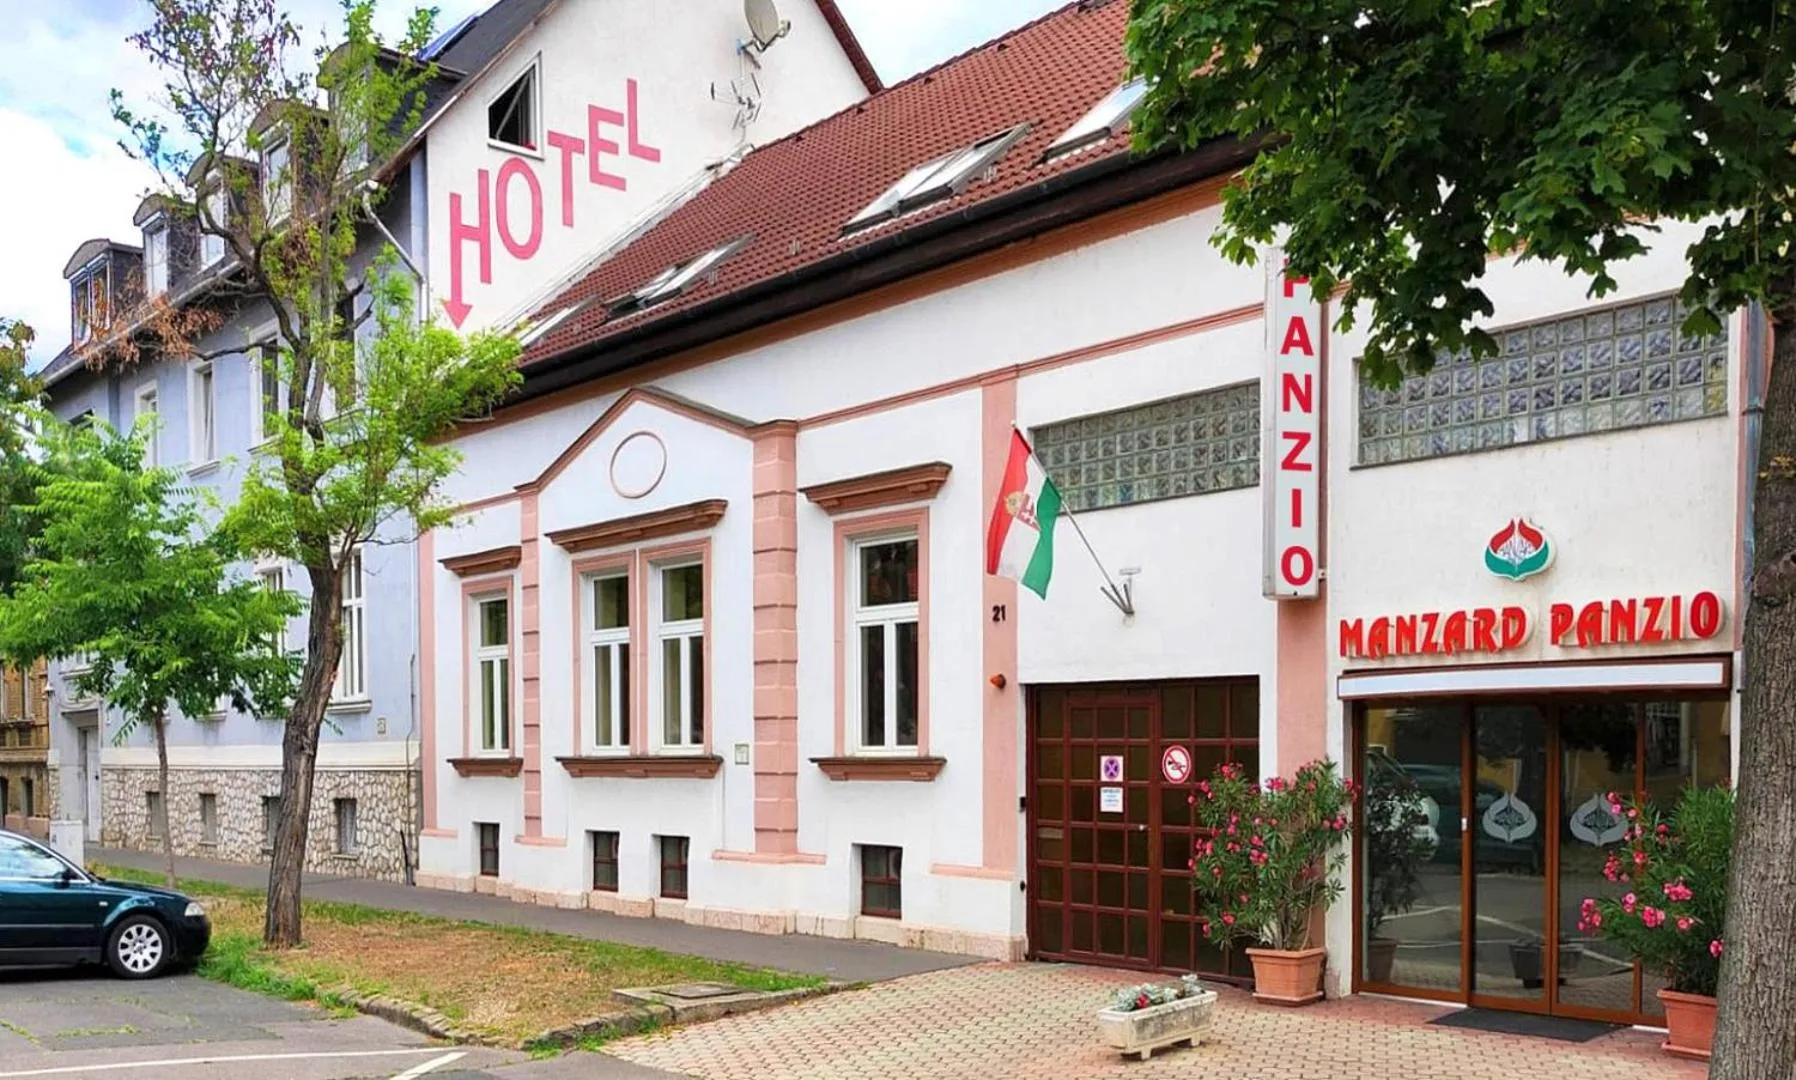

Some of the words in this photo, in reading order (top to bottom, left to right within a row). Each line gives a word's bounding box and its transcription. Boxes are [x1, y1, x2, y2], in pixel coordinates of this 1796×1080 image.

[448, 78, 661, 300] HOTEL
[992, 604, 1006, 623] 21
[1339, 606, 1527, 661] MANZARD
[1549, 591, 1721, 650] PANZIO
